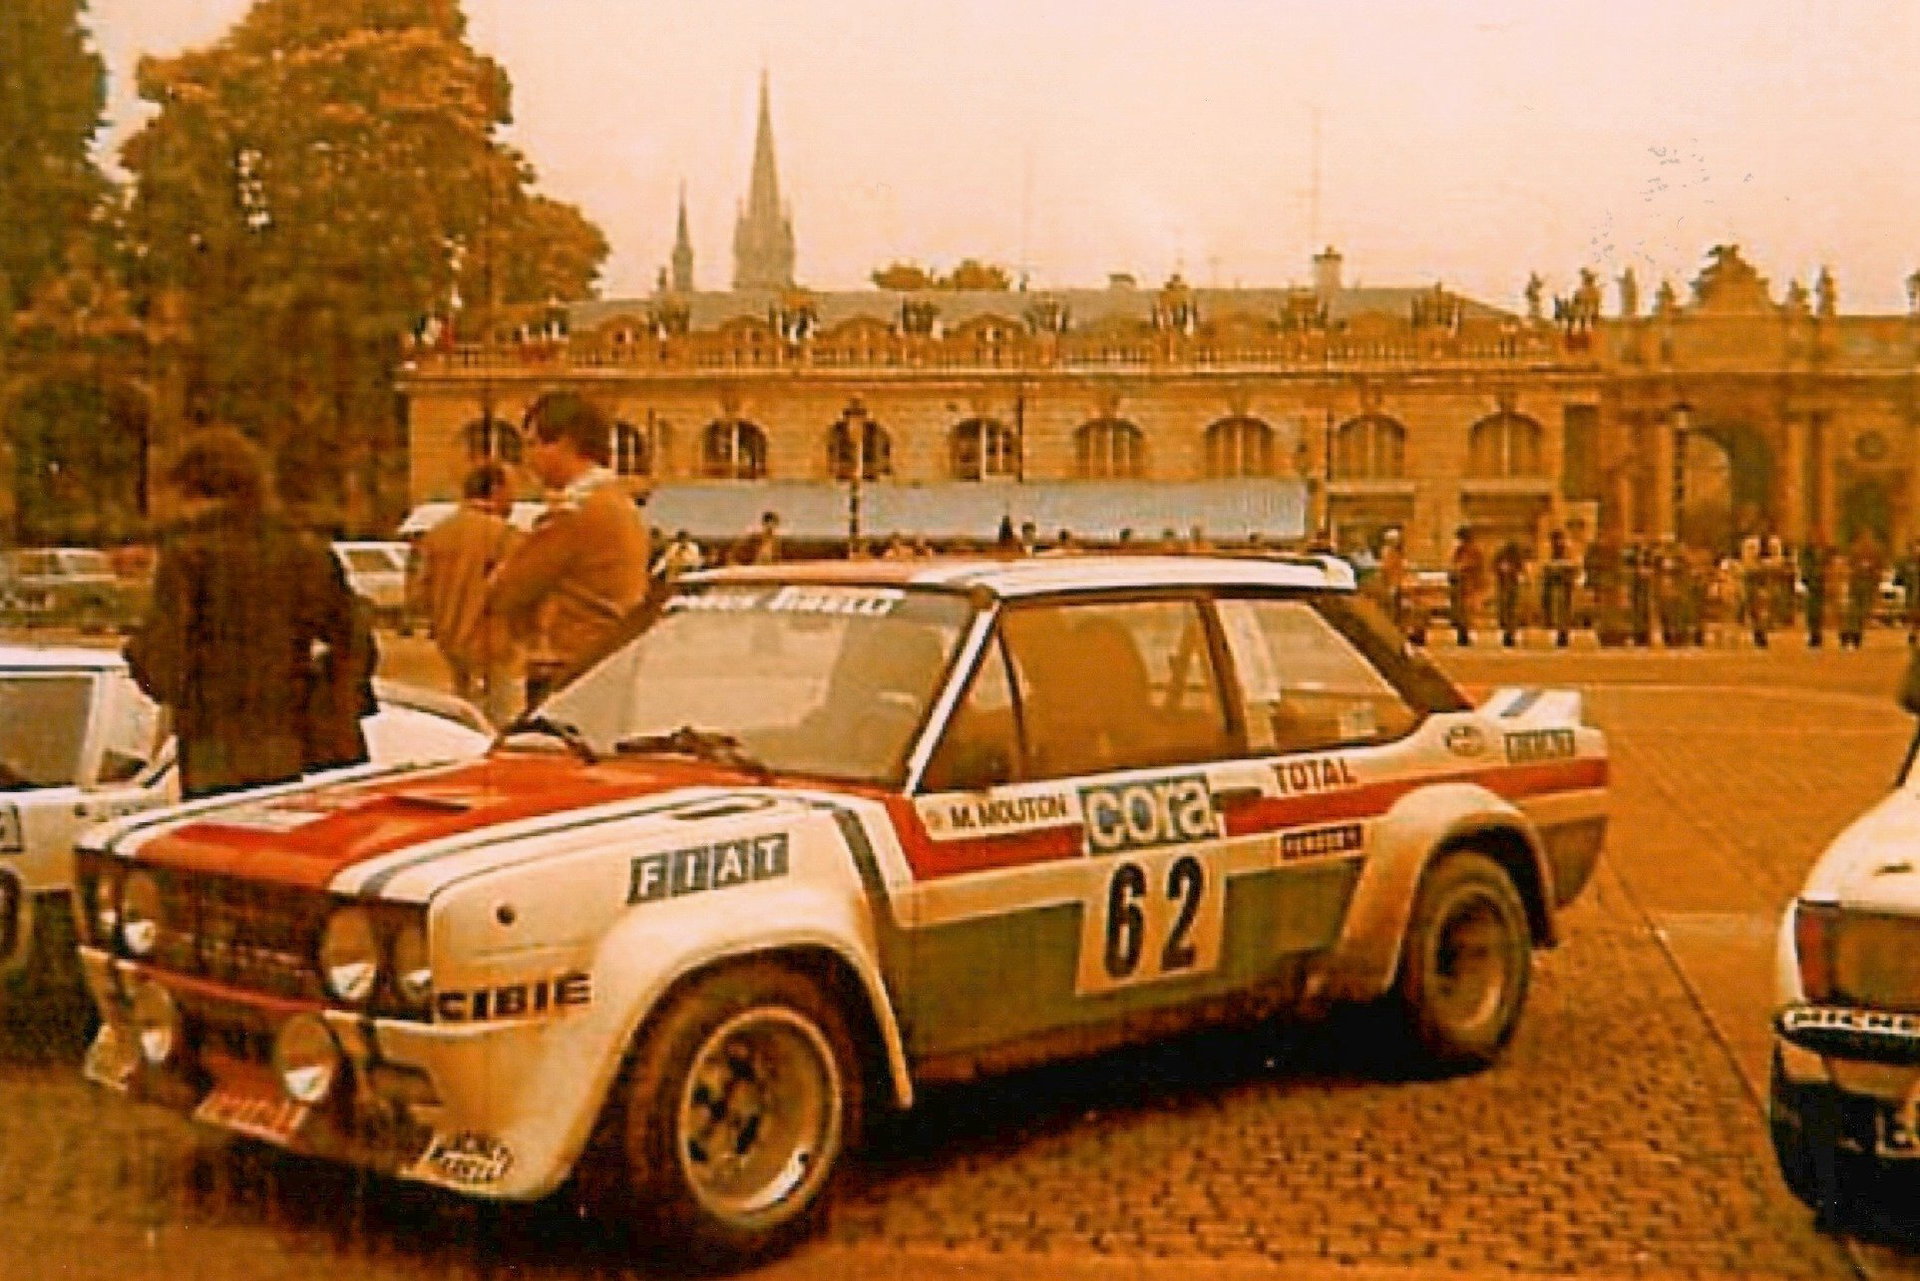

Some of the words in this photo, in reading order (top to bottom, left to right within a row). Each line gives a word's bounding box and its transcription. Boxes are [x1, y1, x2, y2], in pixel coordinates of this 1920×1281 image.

[1270, 756, 1357, 794] TOTAL
[949, 805, 976, 828] M.
[977, 793, 1067, 826] MOUTON
[1088, 780, 1215, 847] cora
[637, 839, 784, 897] FIAT
[1105, 856, 1204, 977] 62
